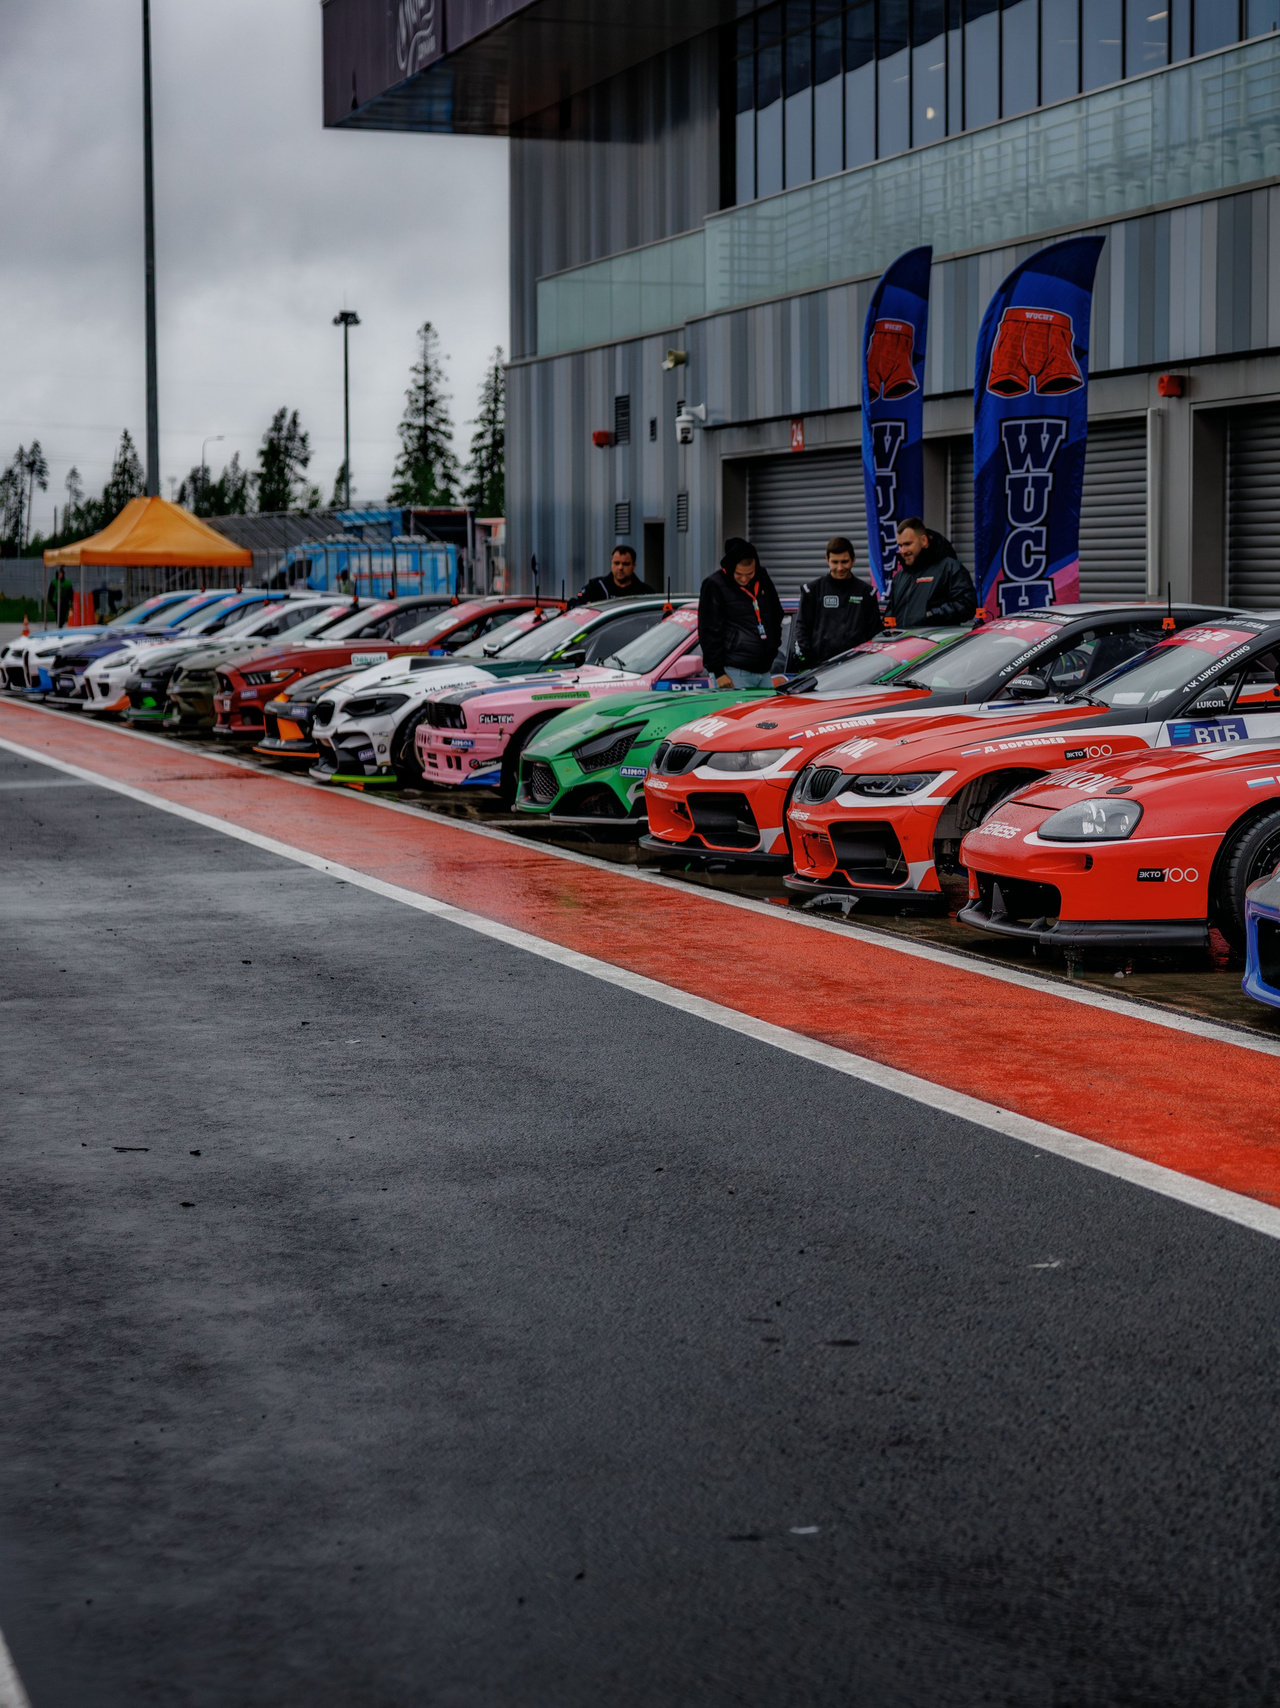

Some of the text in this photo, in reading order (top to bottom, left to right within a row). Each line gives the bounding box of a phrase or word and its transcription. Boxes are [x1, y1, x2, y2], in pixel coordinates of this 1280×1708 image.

[1025, 312, 1055, 321] WUCHT
[1011, 678, 1033, 686] LUKOIL
[1196, 700, 1226, 709] LUKOIL
[1194, 725, 1240, 743] ВТБ
[1066, 744, 1112, 759] ЭКТО 100
[620, 768, 647, 776] AIMOL
[1139, 868, 1199, 883] ЭКТО 100
